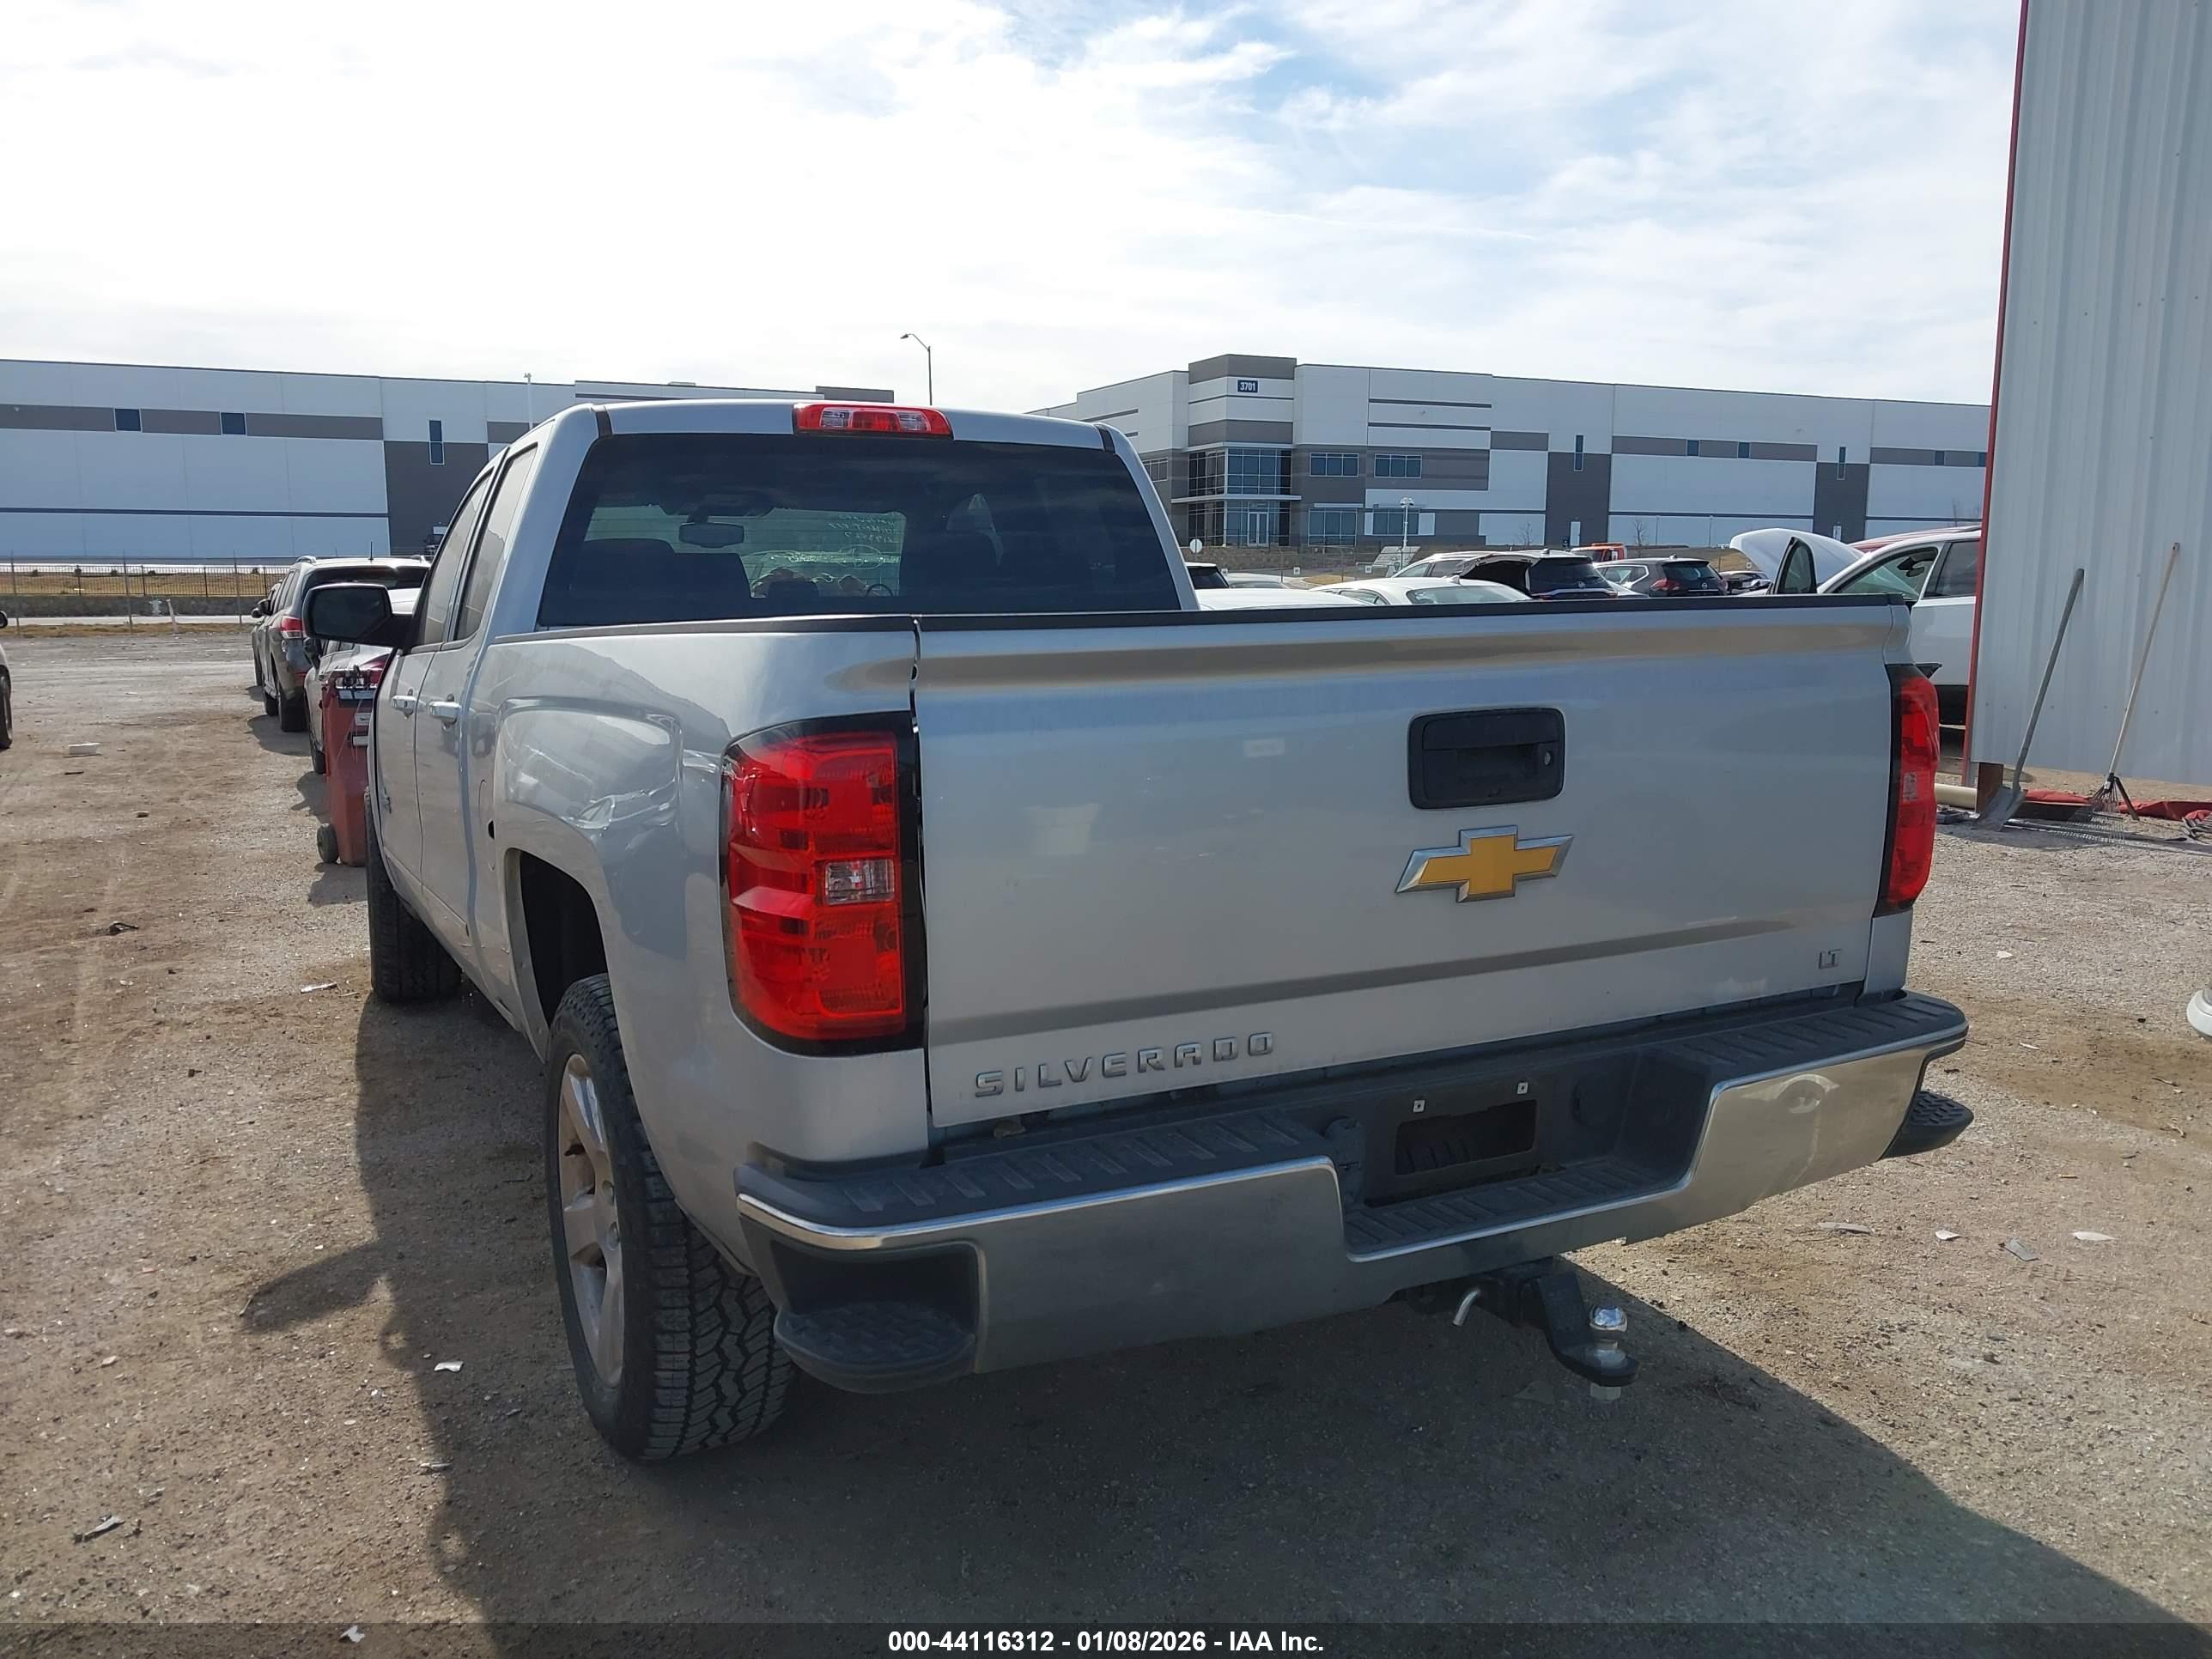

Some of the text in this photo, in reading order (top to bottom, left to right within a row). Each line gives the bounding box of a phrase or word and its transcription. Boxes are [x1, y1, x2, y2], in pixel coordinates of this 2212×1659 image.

[1240, 382, 1256, 392] 3701
[1819, 948, 1842, 969] LT
[975, 1032, 1274, 1097] SILVERADO
